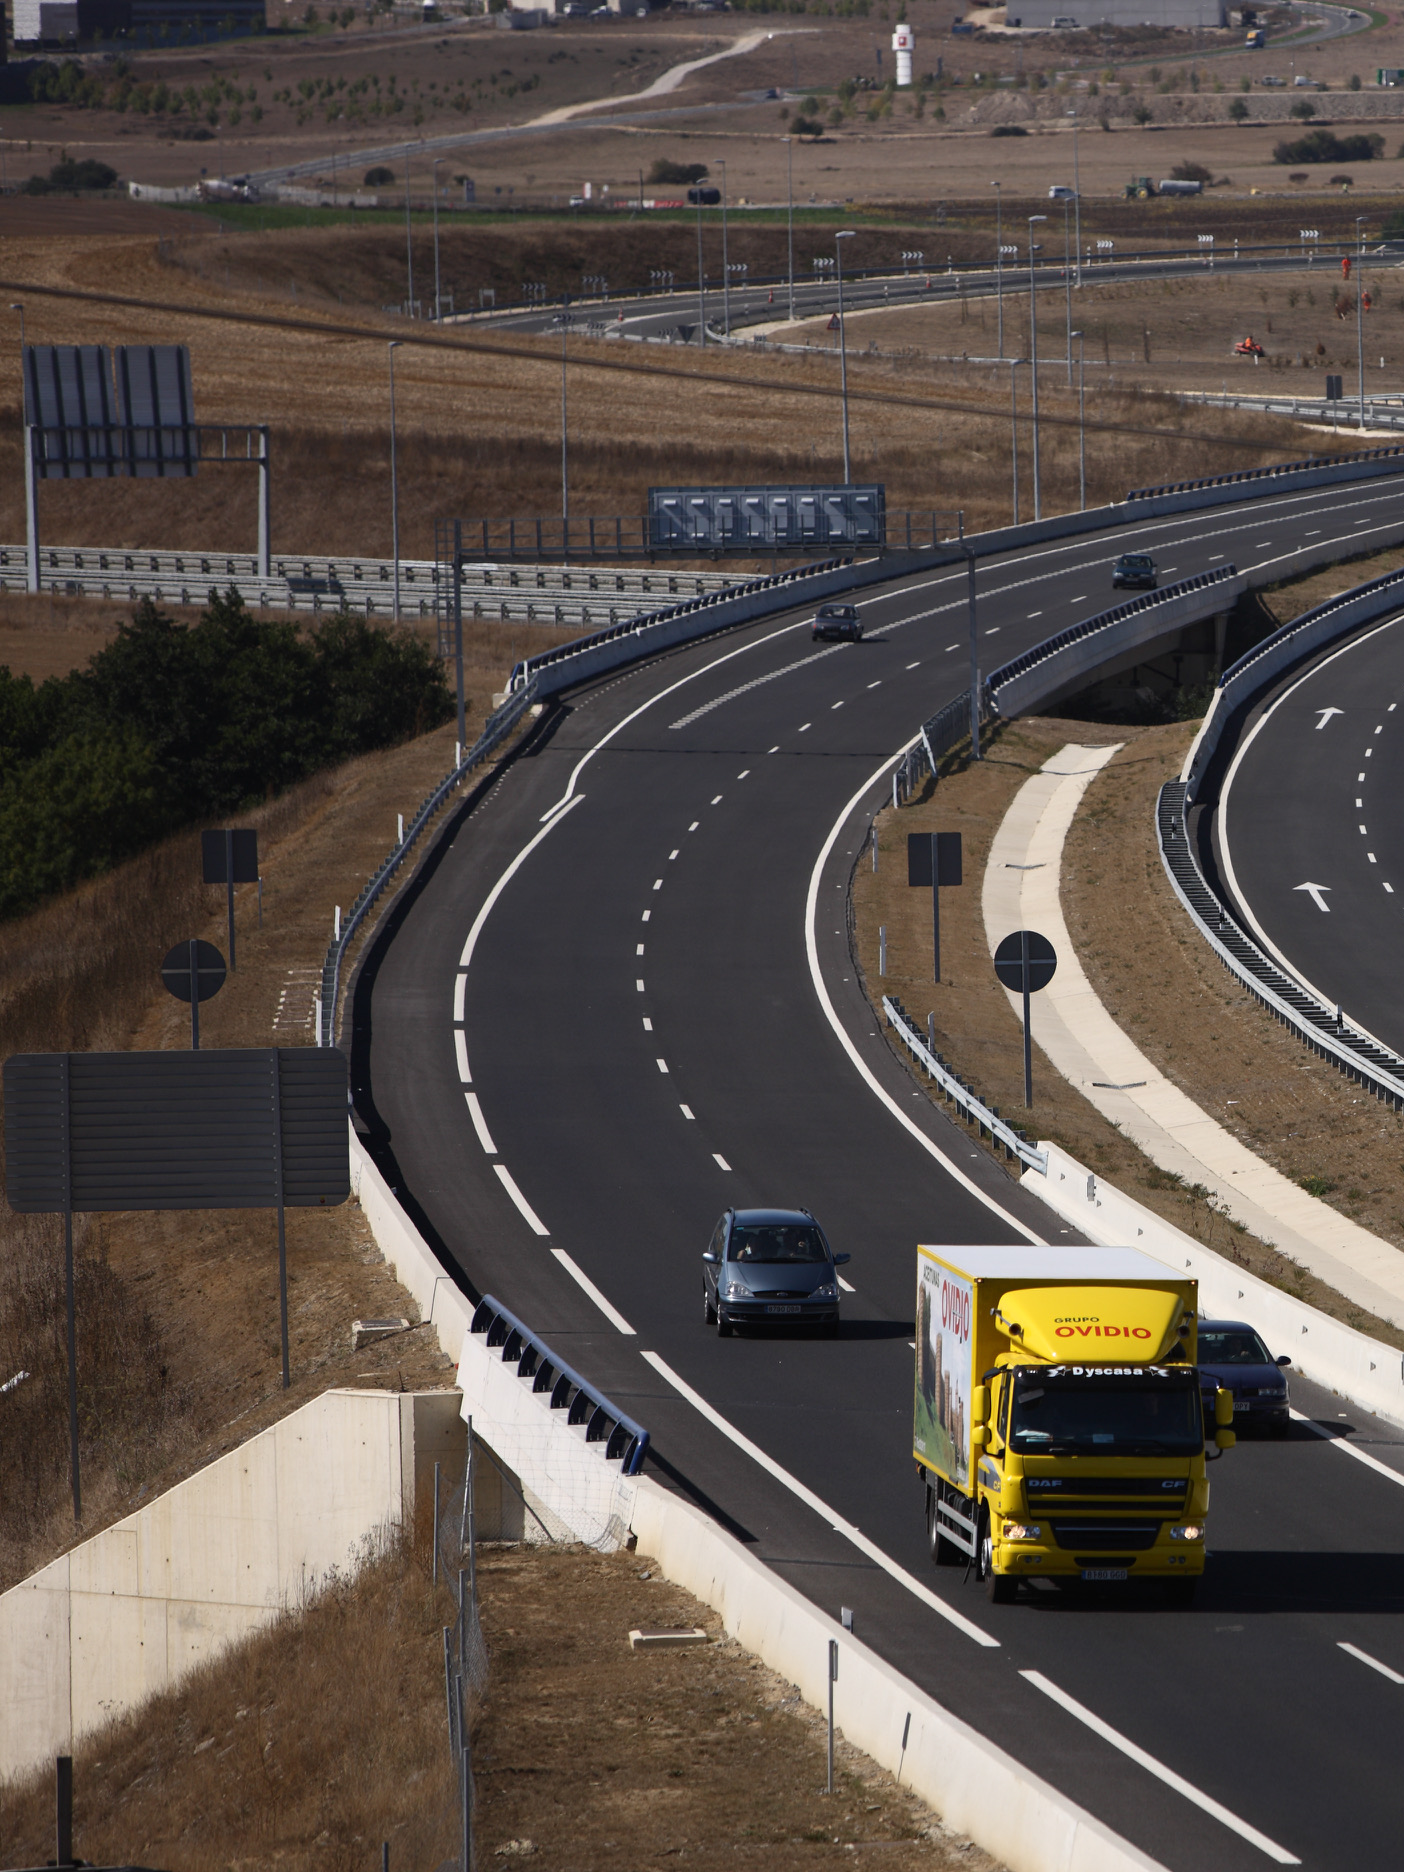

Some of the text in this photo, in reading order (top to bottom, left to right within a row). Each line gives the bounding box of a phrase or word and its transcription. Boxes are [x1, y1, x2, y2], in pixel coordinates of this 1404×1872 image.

[942, 1279, 970, 1342] OVIDIO
[1055, 1325, 1152, 1340] OVIDIO
[1072, 1366, 1144, 1378] Dyscasa
[1028, 1479, 1063, 1487] DAF
[1161, 1480, 1186, 1488] CF
